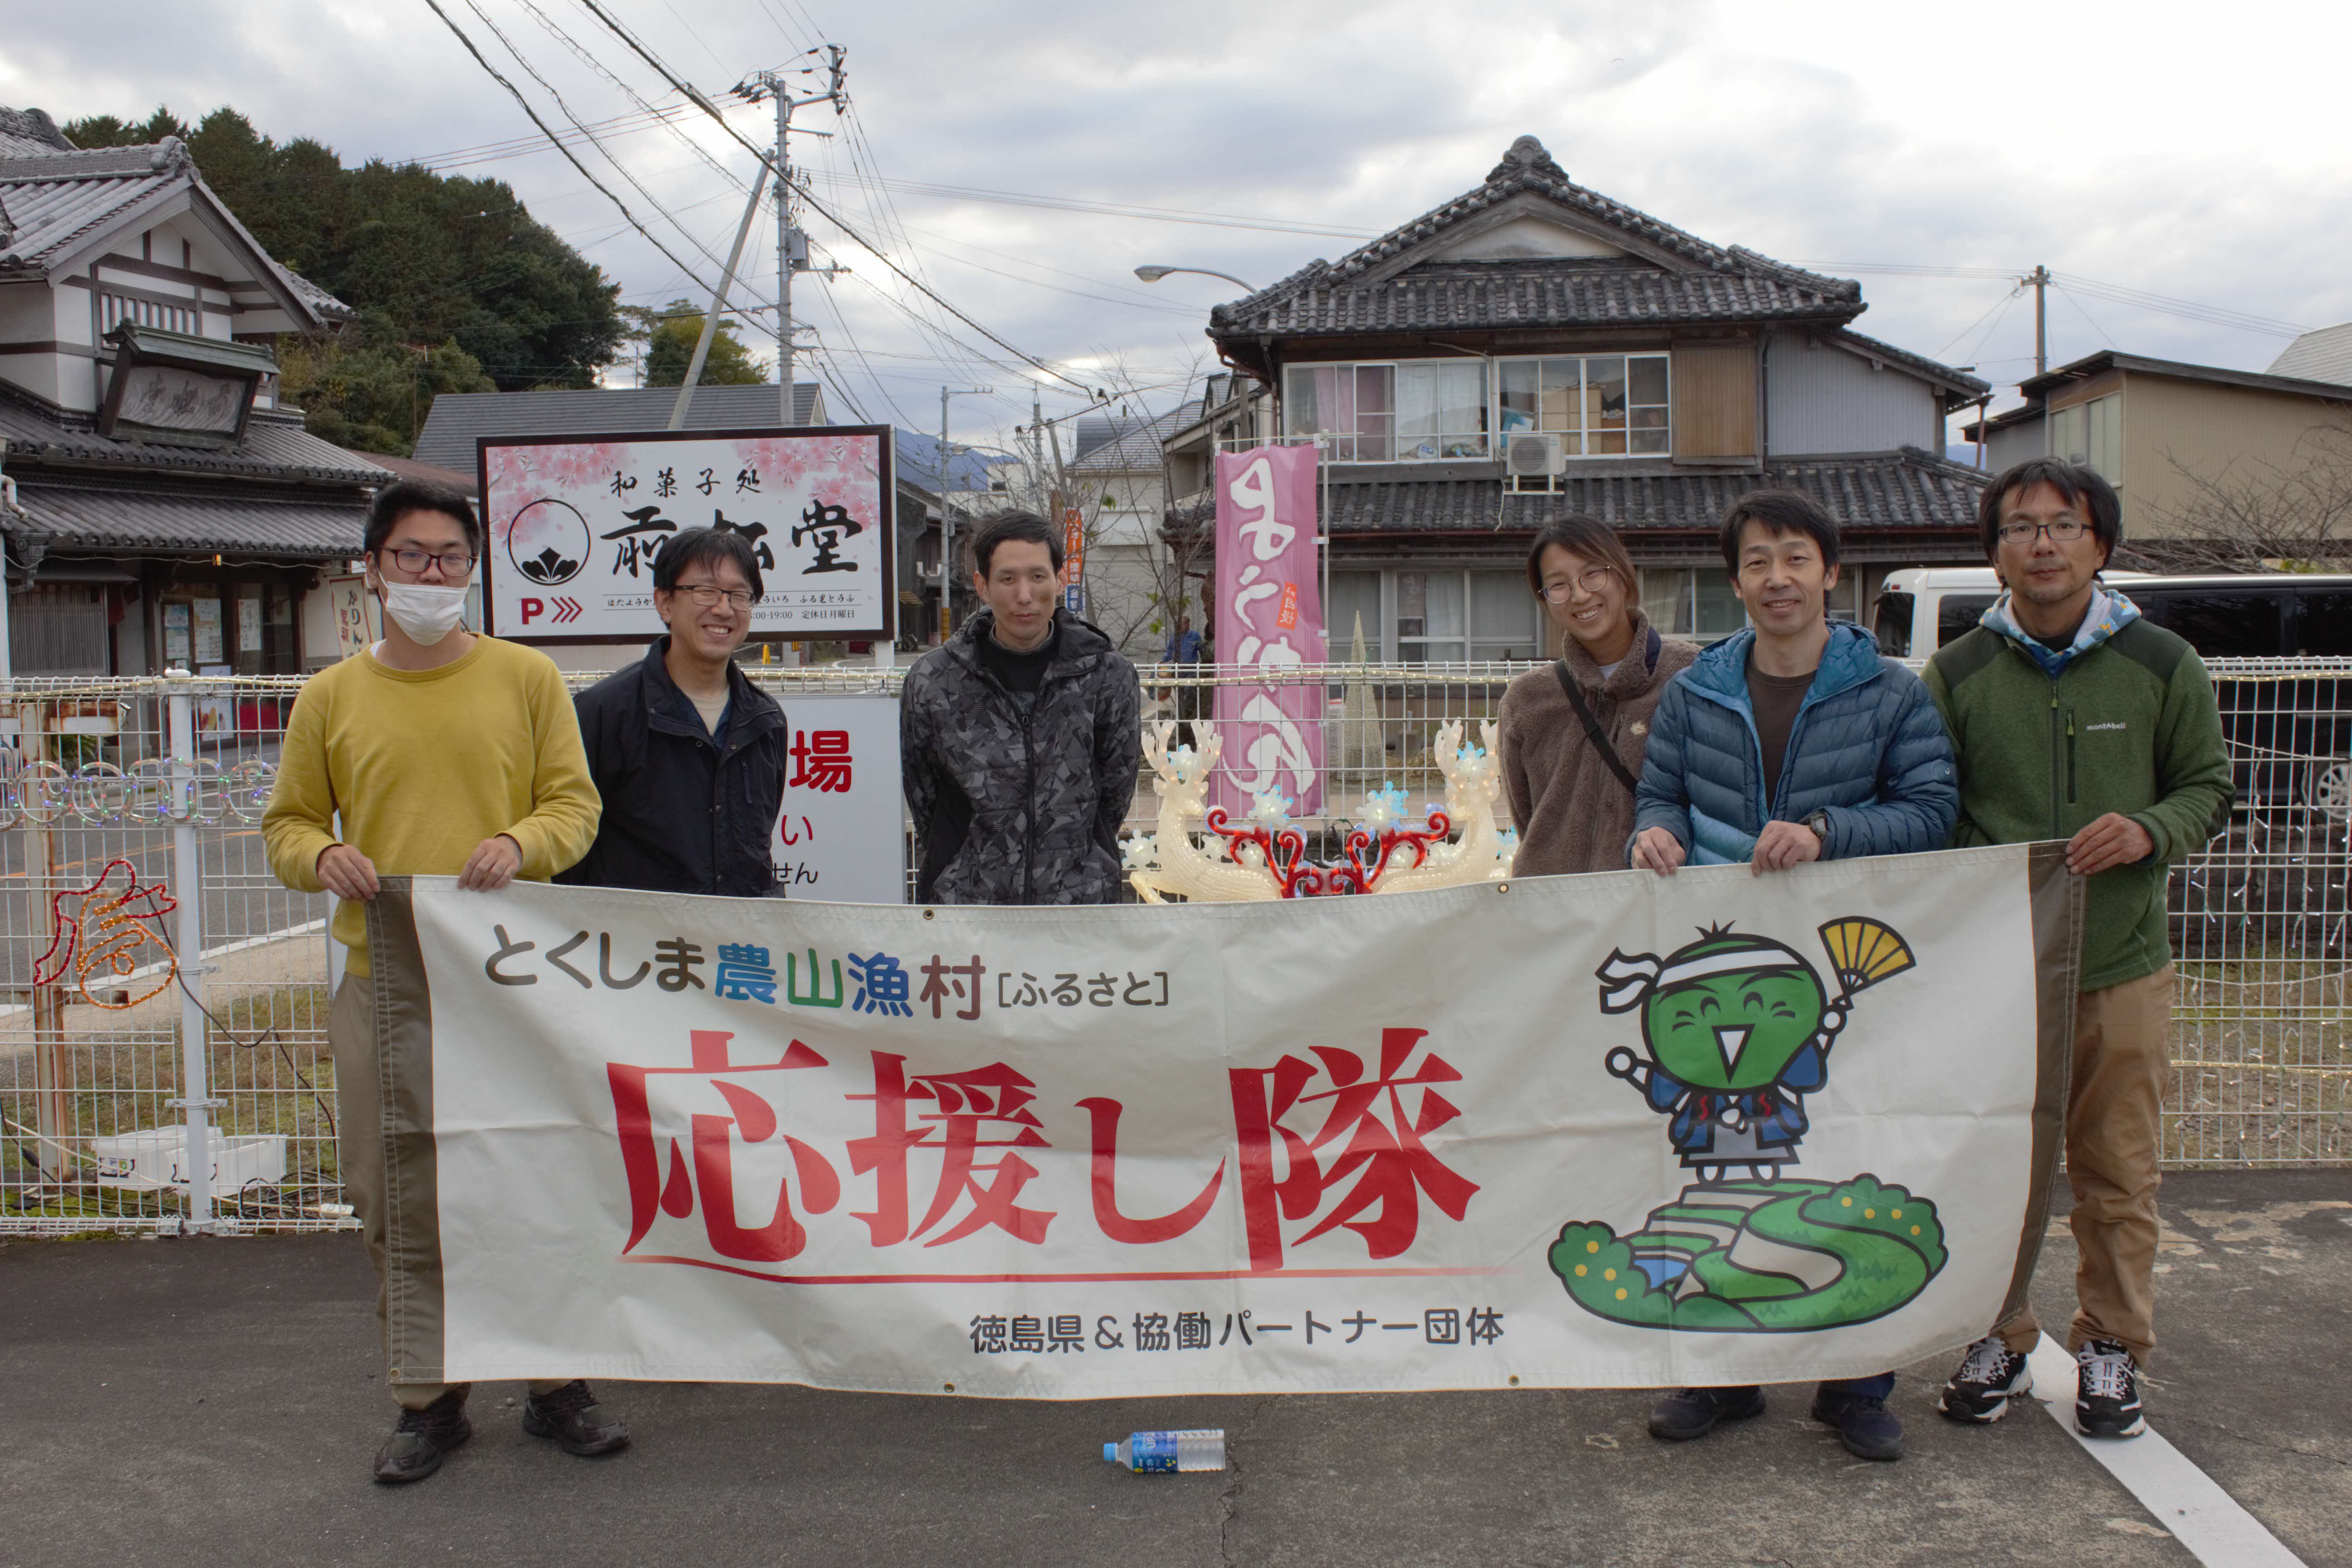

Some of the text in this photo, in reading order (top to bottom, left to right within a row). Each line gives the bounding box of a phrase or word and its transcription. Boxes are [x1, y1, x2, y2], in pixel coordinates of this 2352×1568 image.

[610, 467, 764, 497] 和菓子処
[521, 598, 544, 625] P
[608, 598, 655, 607] はたようか
[750, 611, 793, 619] :00-19:00
[348, 589, 363, 652] かりん
[607, 1027, 1480, 1272] 応援し隊
